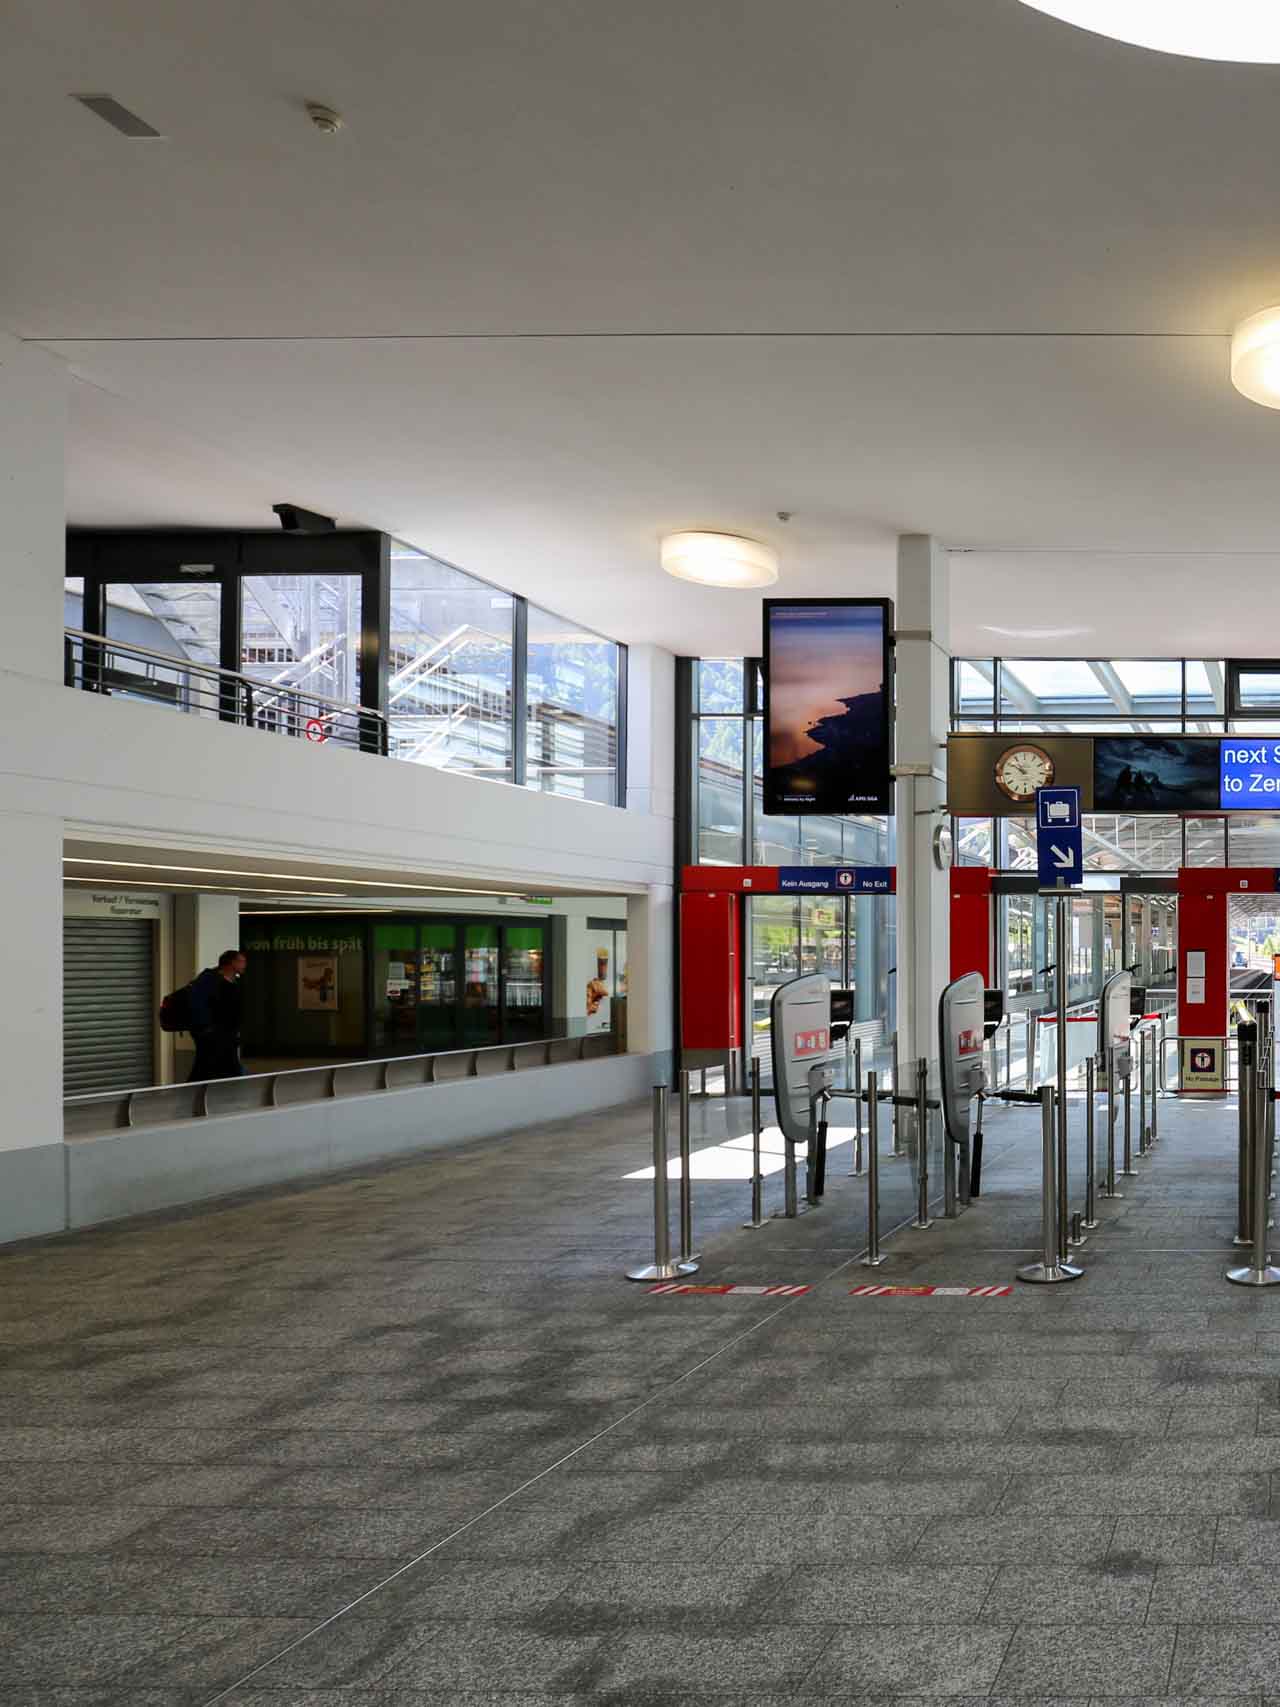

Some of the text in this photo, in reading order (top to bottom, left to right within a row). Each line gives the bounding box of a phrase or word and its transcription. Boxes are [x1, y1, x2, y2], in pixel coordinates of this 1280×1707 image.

[1224, 748, 1267, 764] next
[1224, 776, 1243, 793] to
[799, 880, 829, 888] Ausgang
